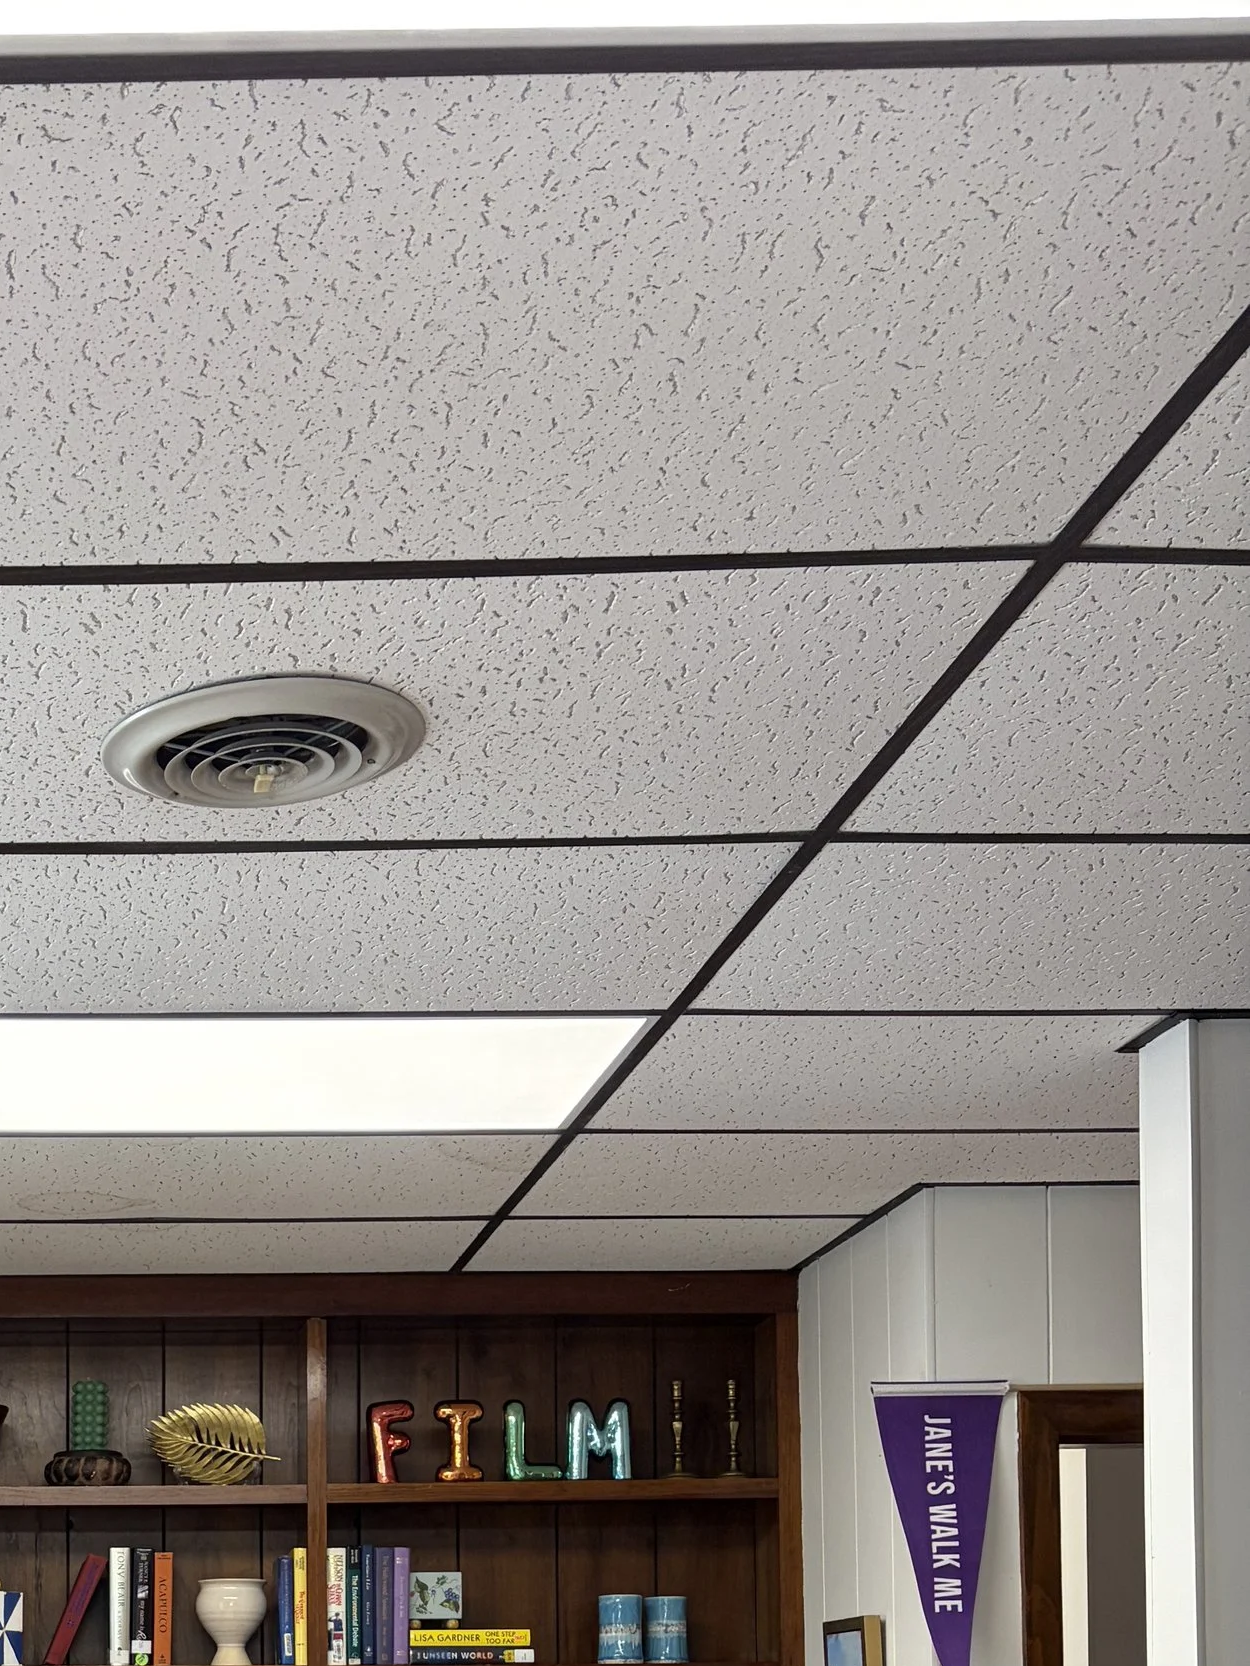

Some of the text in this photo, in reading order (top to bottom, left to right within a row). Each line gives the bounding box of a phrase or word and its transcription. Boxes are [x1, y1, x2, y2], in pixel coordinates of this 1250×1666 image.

[366, 1399, 632, 1483] FILM
[924, 1414, 963, 1613] JANE'S WALK ME
[117, 1551, 125, 1608] TONY BLAIR
[158, 1576, 167, 1633] ACAPULCO
[414, 1634, 480, 1642] LISA GARDNER
